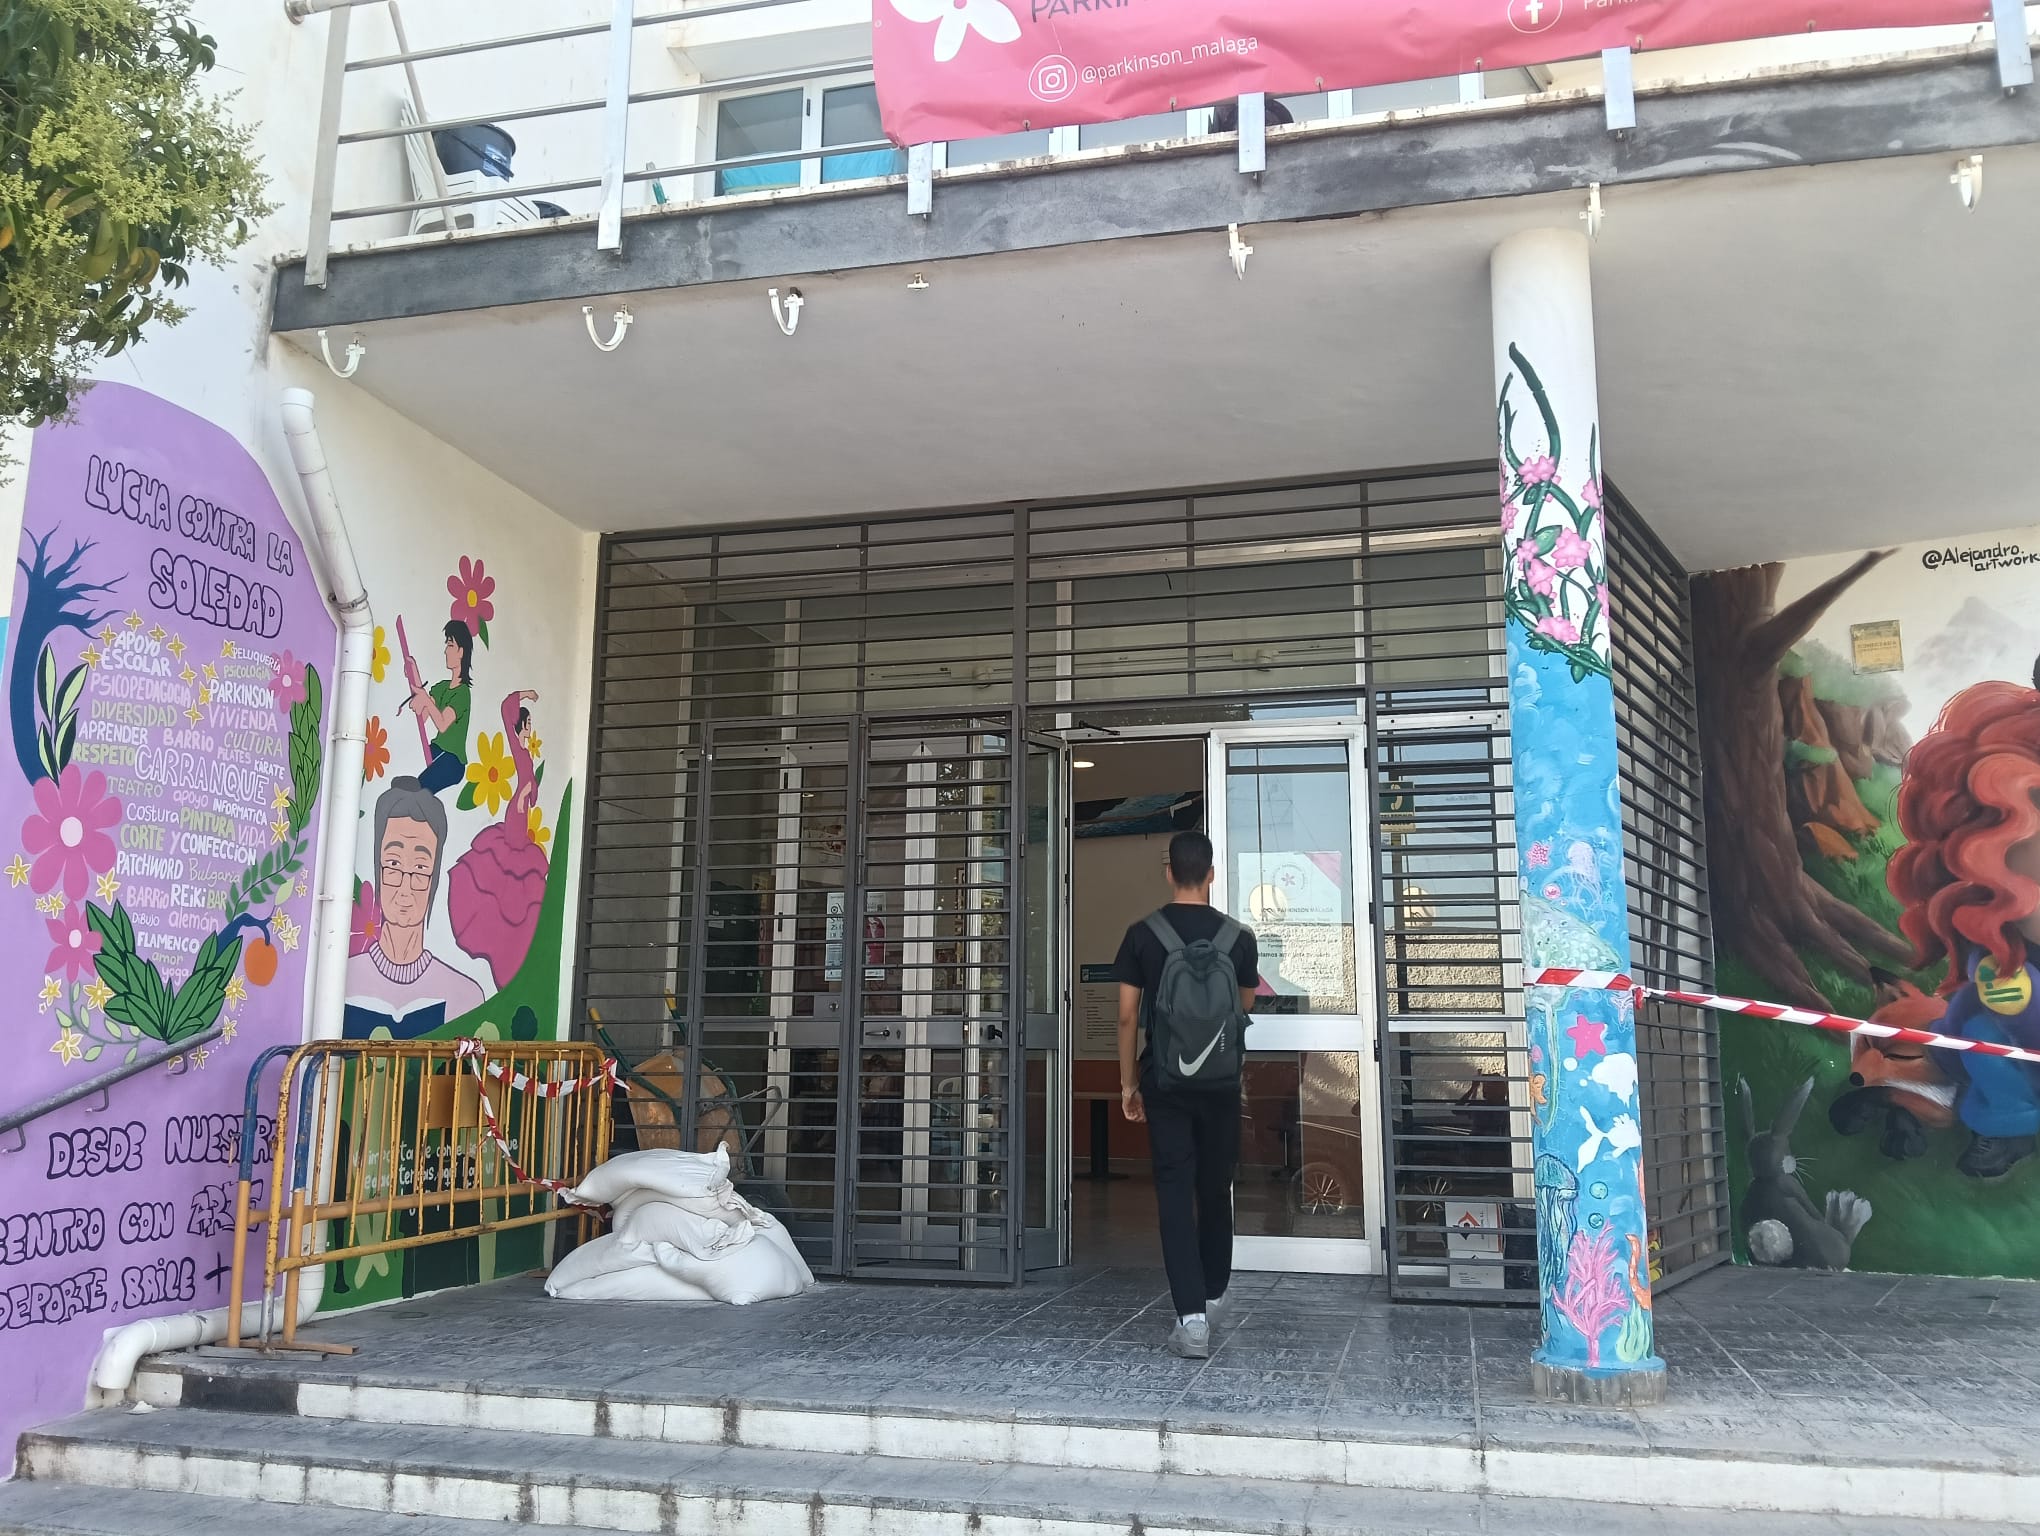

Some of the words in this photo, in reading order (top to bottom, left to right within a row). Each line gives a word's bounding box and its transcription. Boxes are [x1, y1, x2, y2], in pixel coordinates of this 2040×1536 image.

[1081, 36, 1258, 85] @parkinson_malaga
[85, 454, 171, 531] LUCHA
[178, 495, 255, 562] CONTRA
[267, 532, 293, 576] LA
[148, 548, 283, 638] SOLEDAD
[114, 630, 161, 657] APOYO
[101, 647, 172, 678] ESCOLAR
[209, 679, 275, 709] PARKINSON
[91, 699, 178, 728] DIVERSIDAD
[78, 720, 149, 746] APRENDER
[223, 730, 284, 760] CULTURA
[71, 742, 137, 767] RESPETO
[106, 775, 164, 799] TEATRO
[134, 744, 270, 806] CARRANQUE
[126, 802, 180, 825] Costura
[179, 806, 236, 842] PINTURA
[119, 823, 166, 852] CORTE
[168, 830, 181, 856] Y
[115, 850, 185, 881] PATCHWORD
[188, 857, 240, 888] Bulgaria
[137, 931, 200, 954] FLAMENCO
[47, 1121, 147, 1179] DESDE
[165, 1113, 280, 1165] NUESR
[119, 1202, 175, 1244] CON
[187, 1178, 264, 1238] ARE
